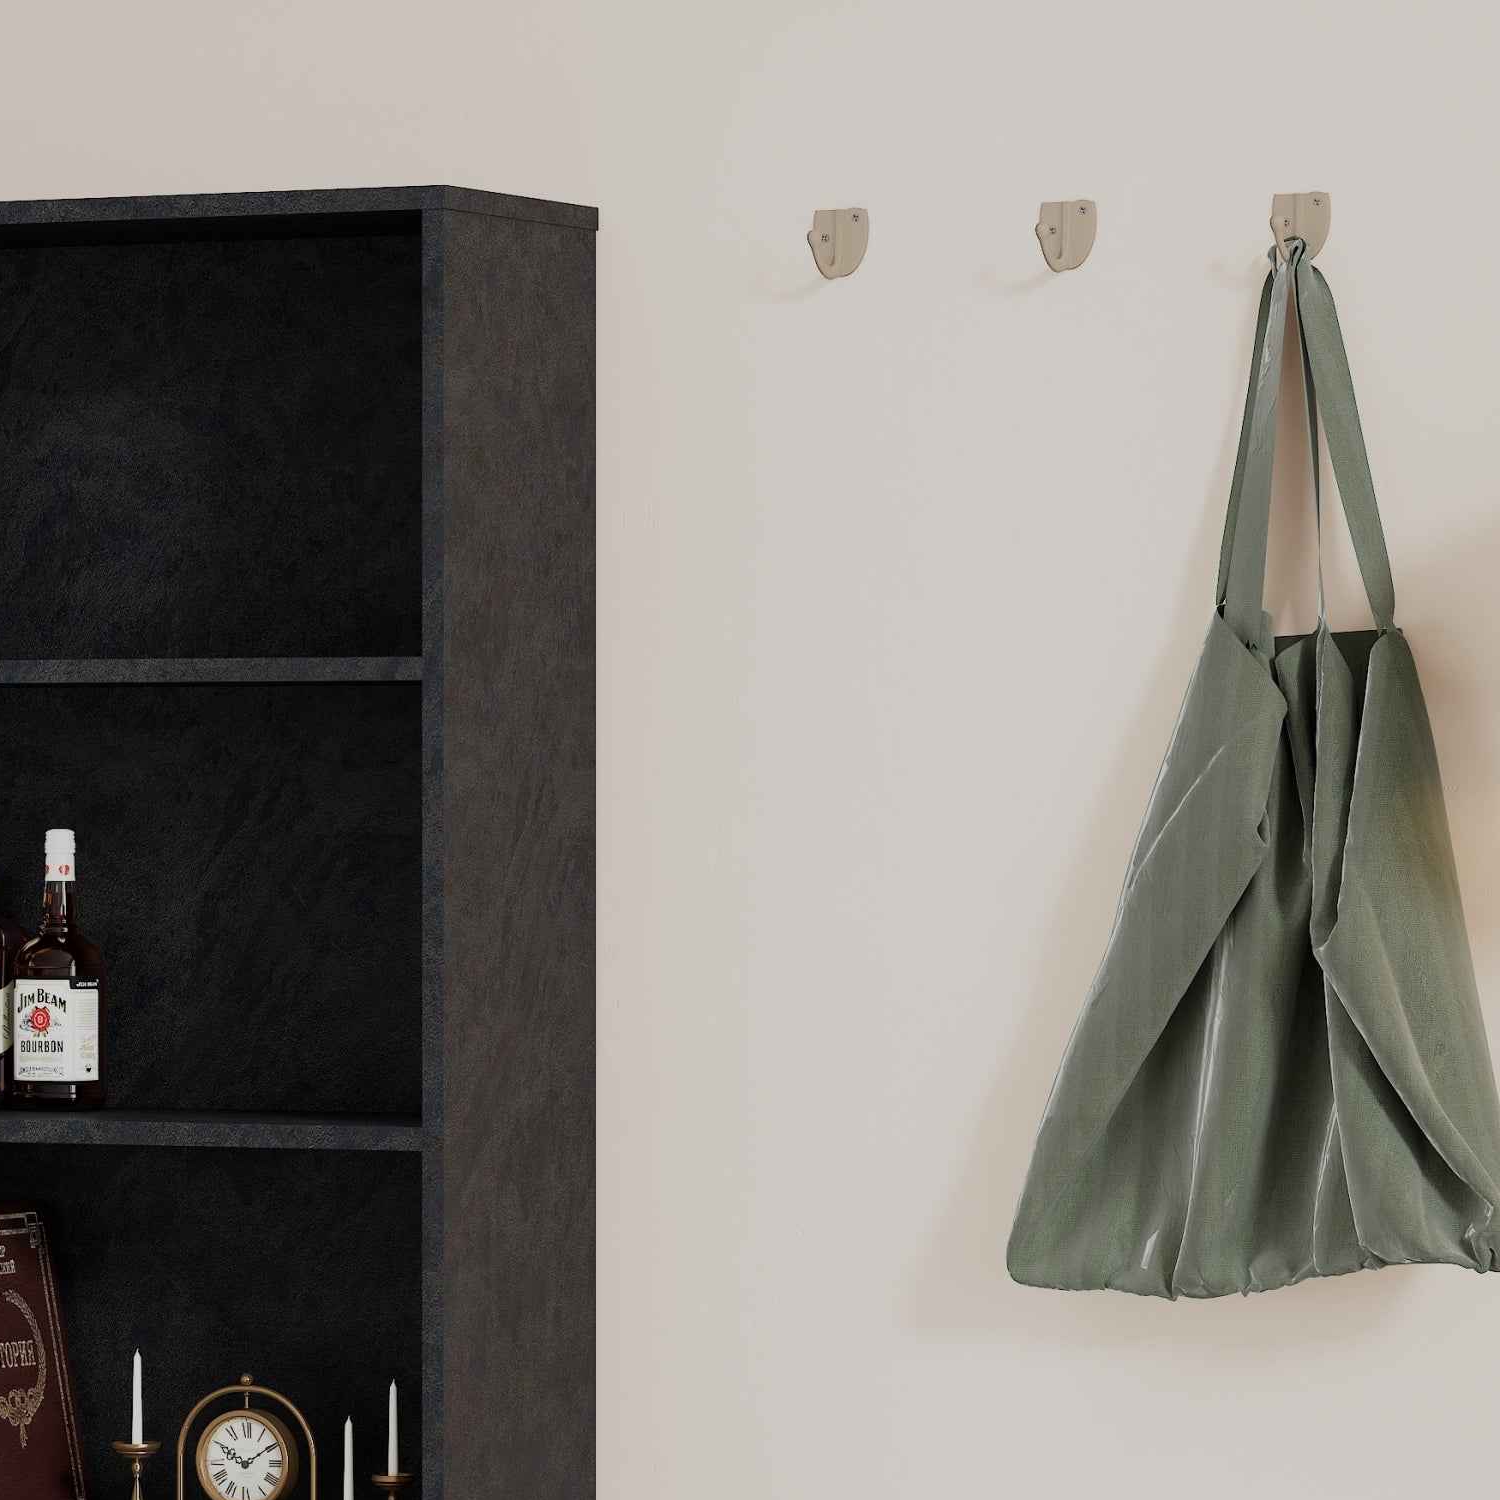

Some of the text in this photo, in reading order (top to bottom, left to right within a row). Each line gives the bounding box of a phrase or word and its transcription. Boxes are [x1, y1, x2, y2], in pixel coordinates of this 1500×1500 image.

[18, 989, 67, 1013] JIM BEAM
[20, 1040, 64, 1053] BOURBON
